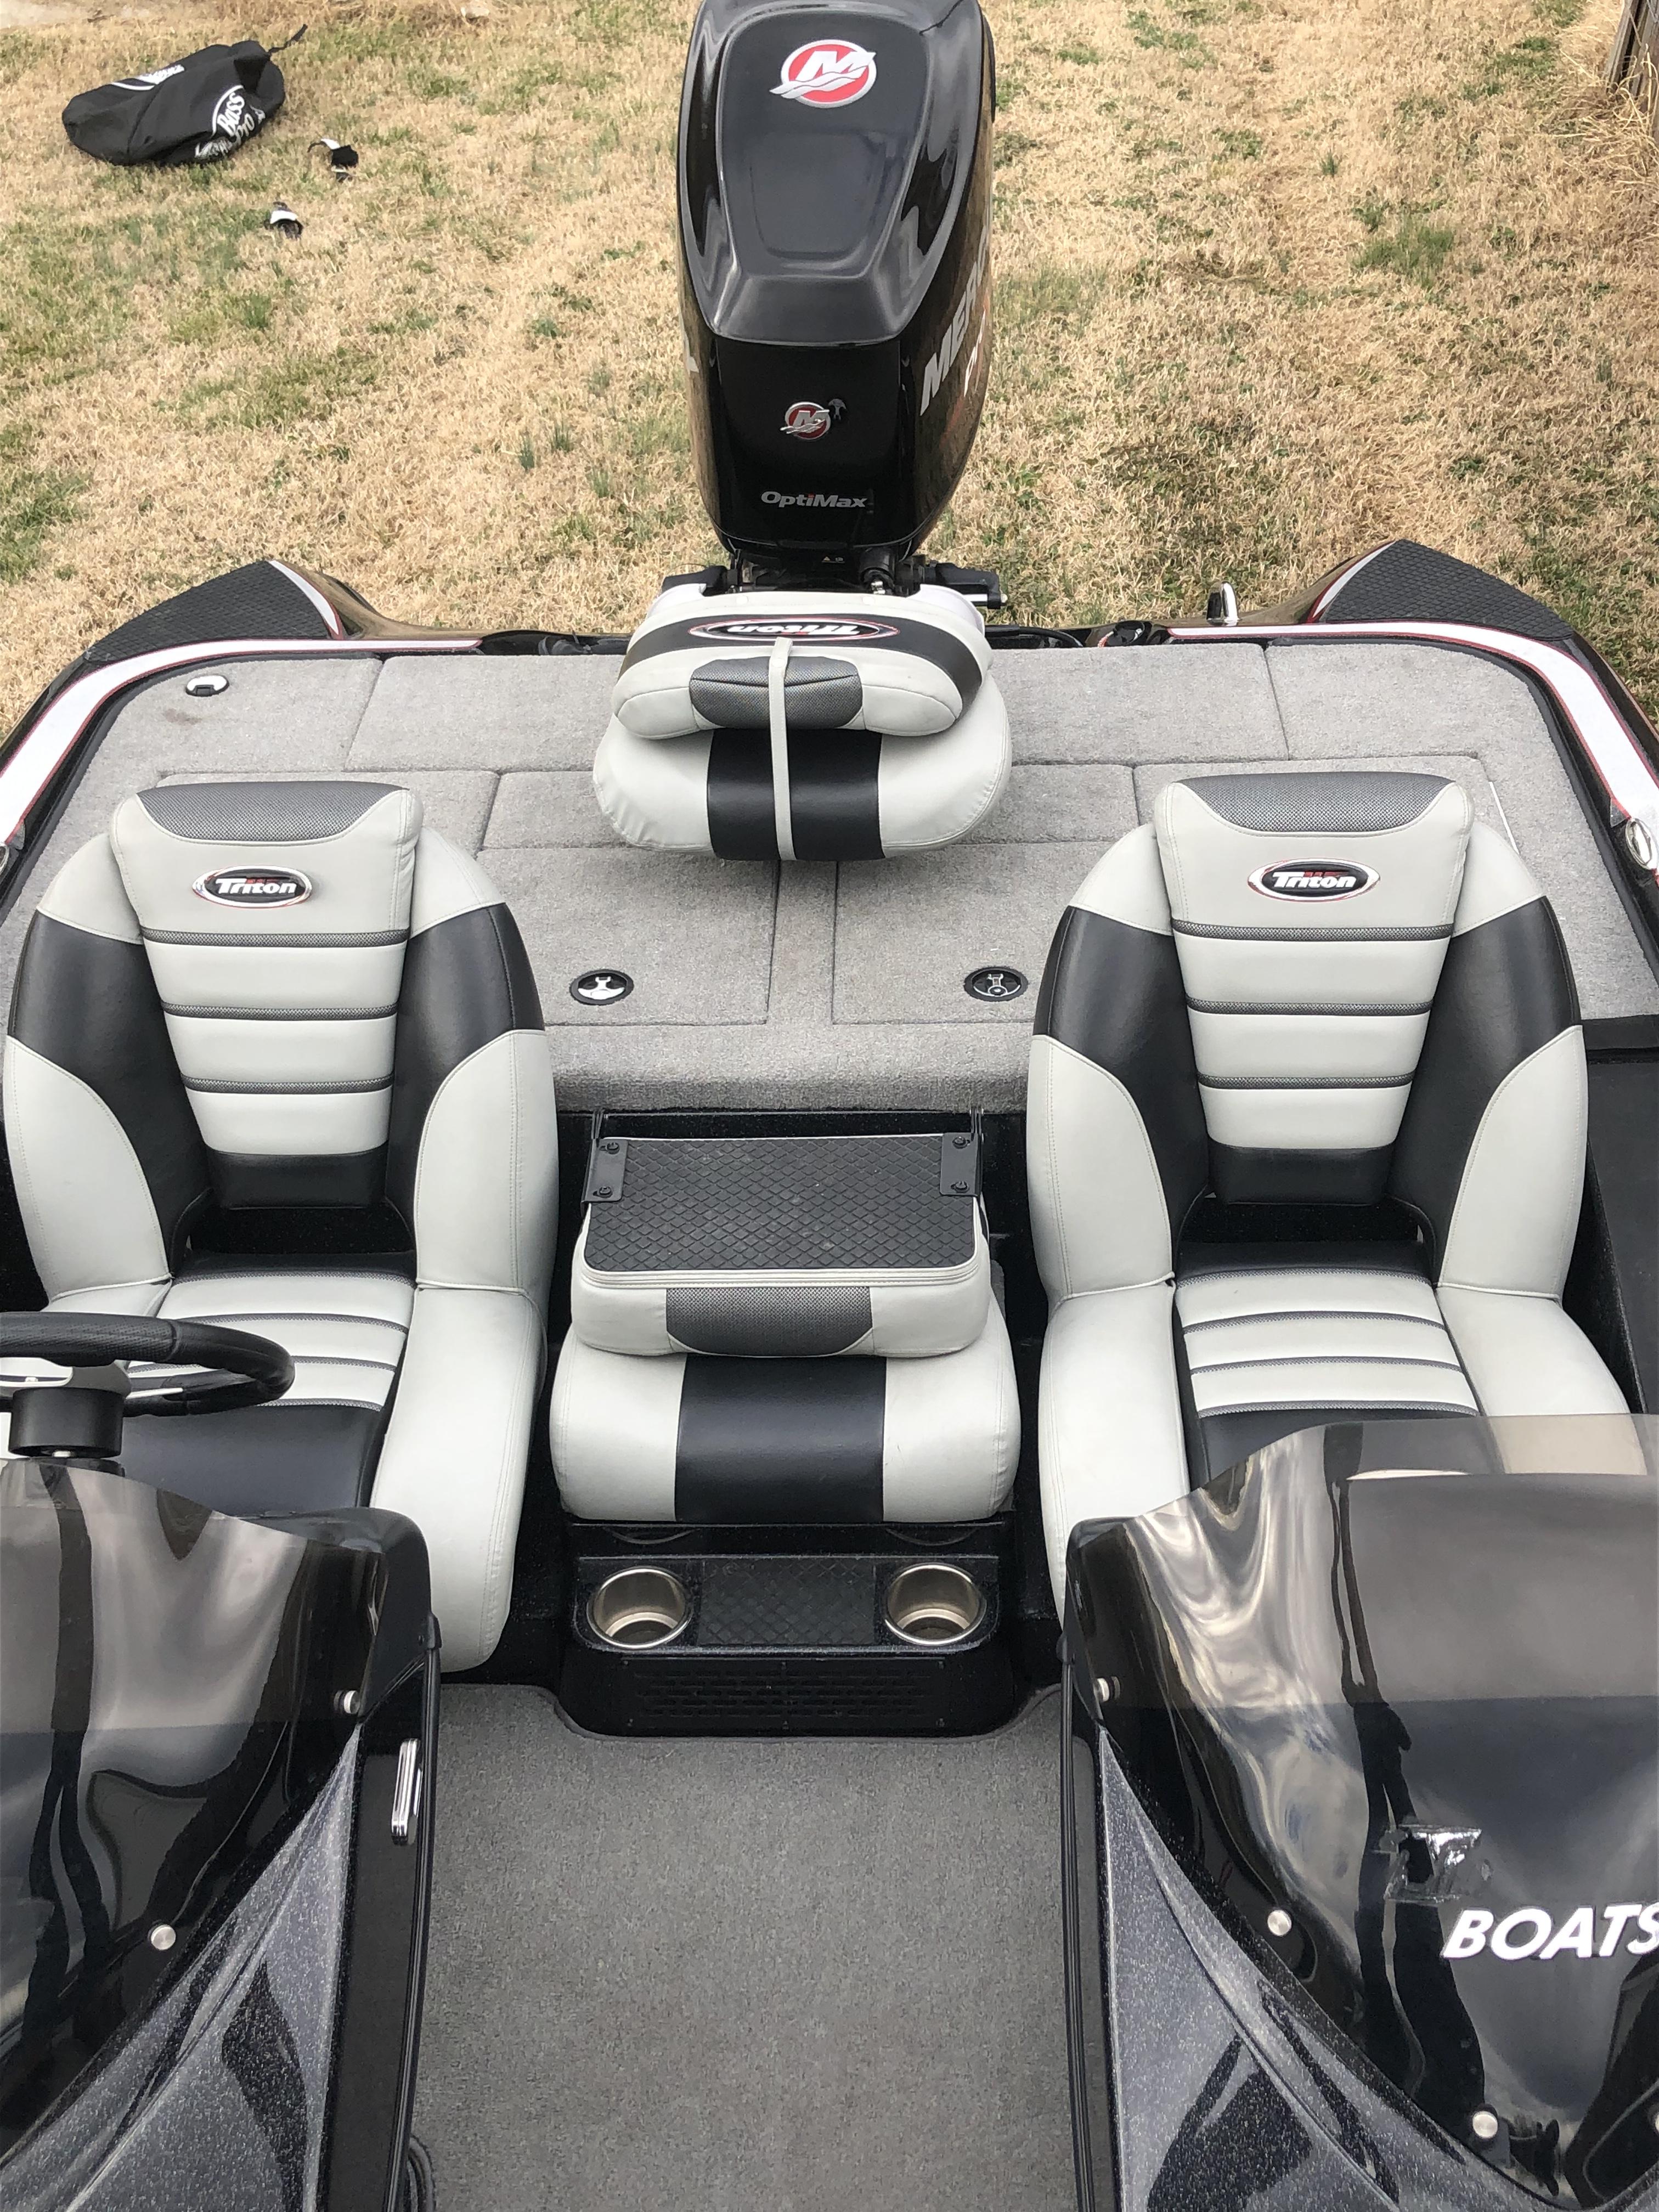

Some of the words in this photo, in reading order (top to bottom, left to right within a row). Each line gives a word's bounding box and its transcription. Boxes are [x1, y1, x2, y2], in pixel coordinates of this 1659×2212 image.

[217, 92, 245, 137] Bass
[761, 491, 867, 508] OptiMax
[215, 878, 297, 894] Triton
[1272, 871, 1357, 888] Triton
[1441, 1903, 1659, 1960] BOATS
